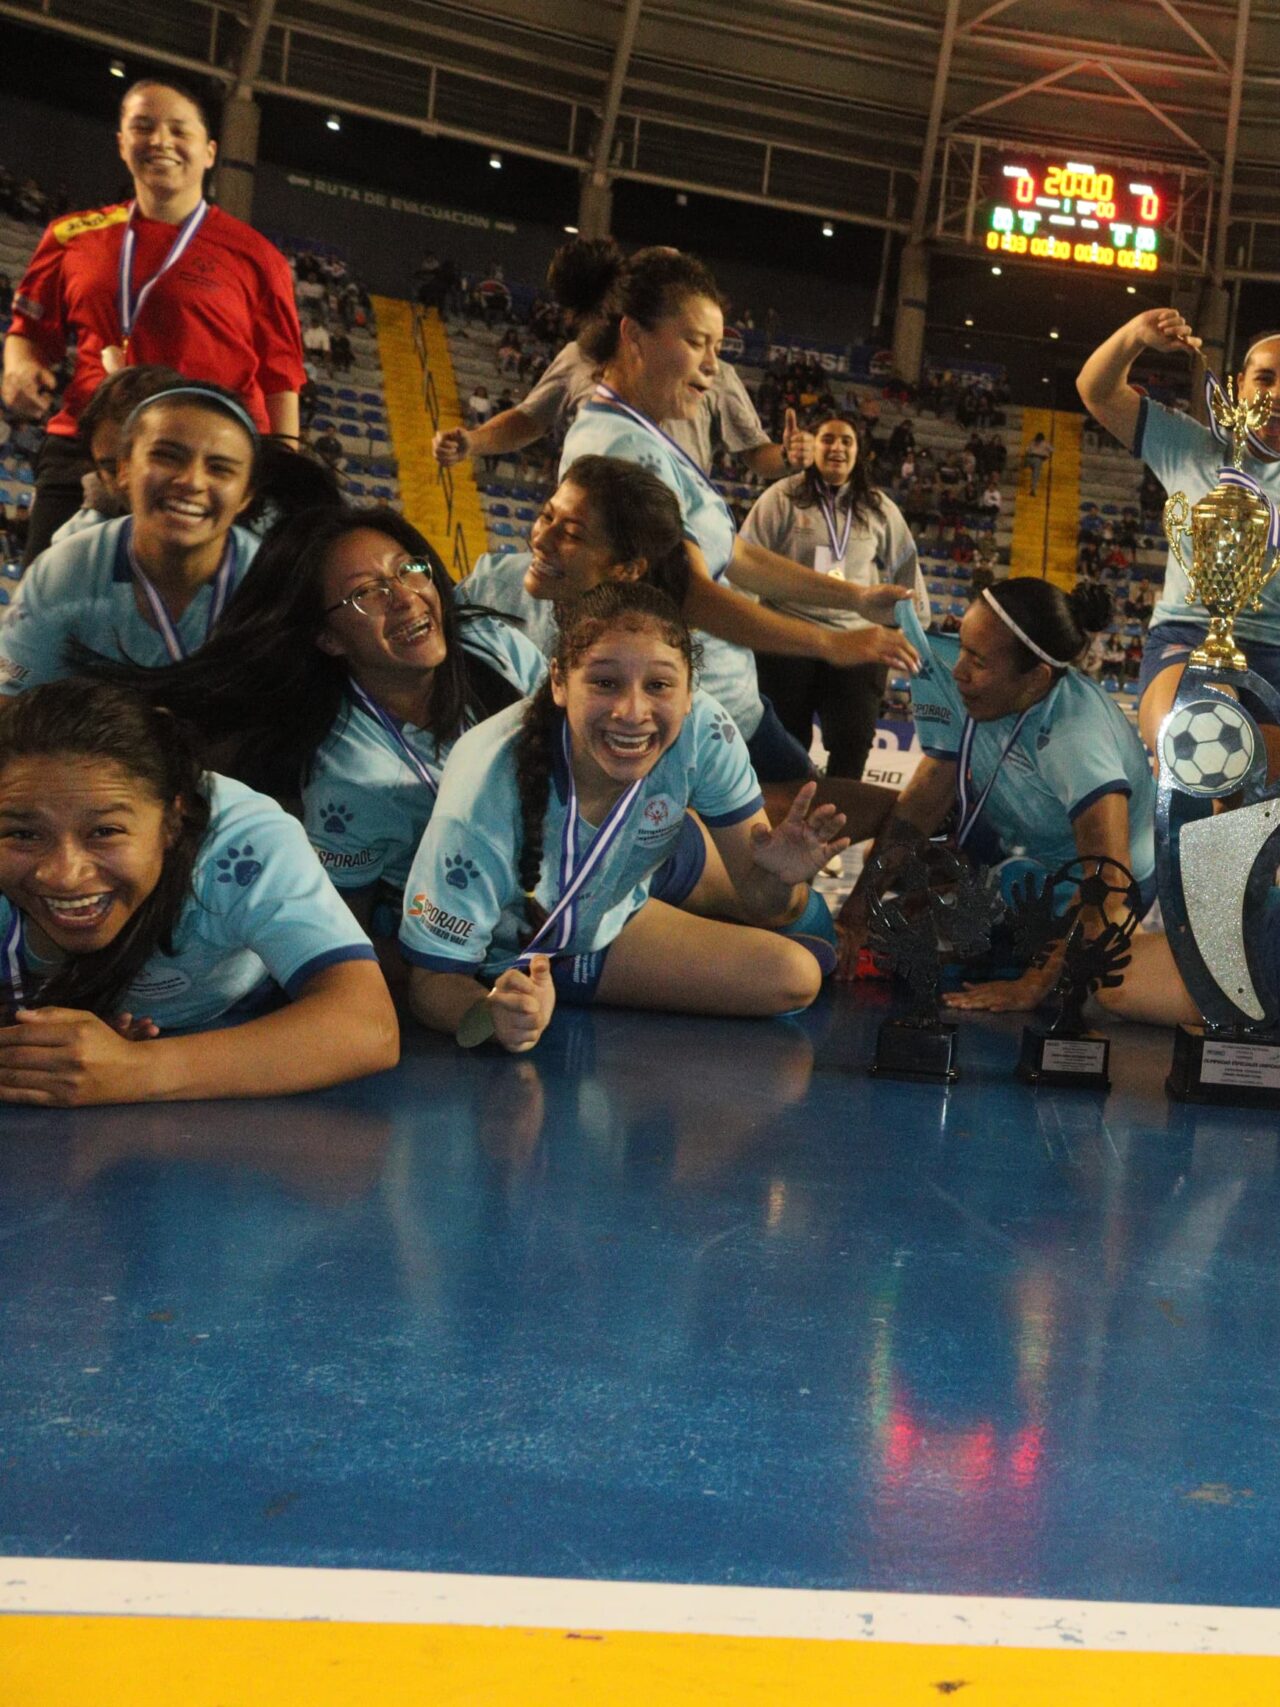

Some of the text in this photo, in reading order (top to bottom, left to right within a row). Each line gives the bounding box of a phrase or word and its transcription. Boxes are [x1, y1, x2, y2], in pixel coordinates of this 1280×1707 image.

[1044, 166, 1114, 202] 20:00
[314, 179, 491, 229] RUTA DE EVACUACION
[912, 703, 952, 719] PORADE
